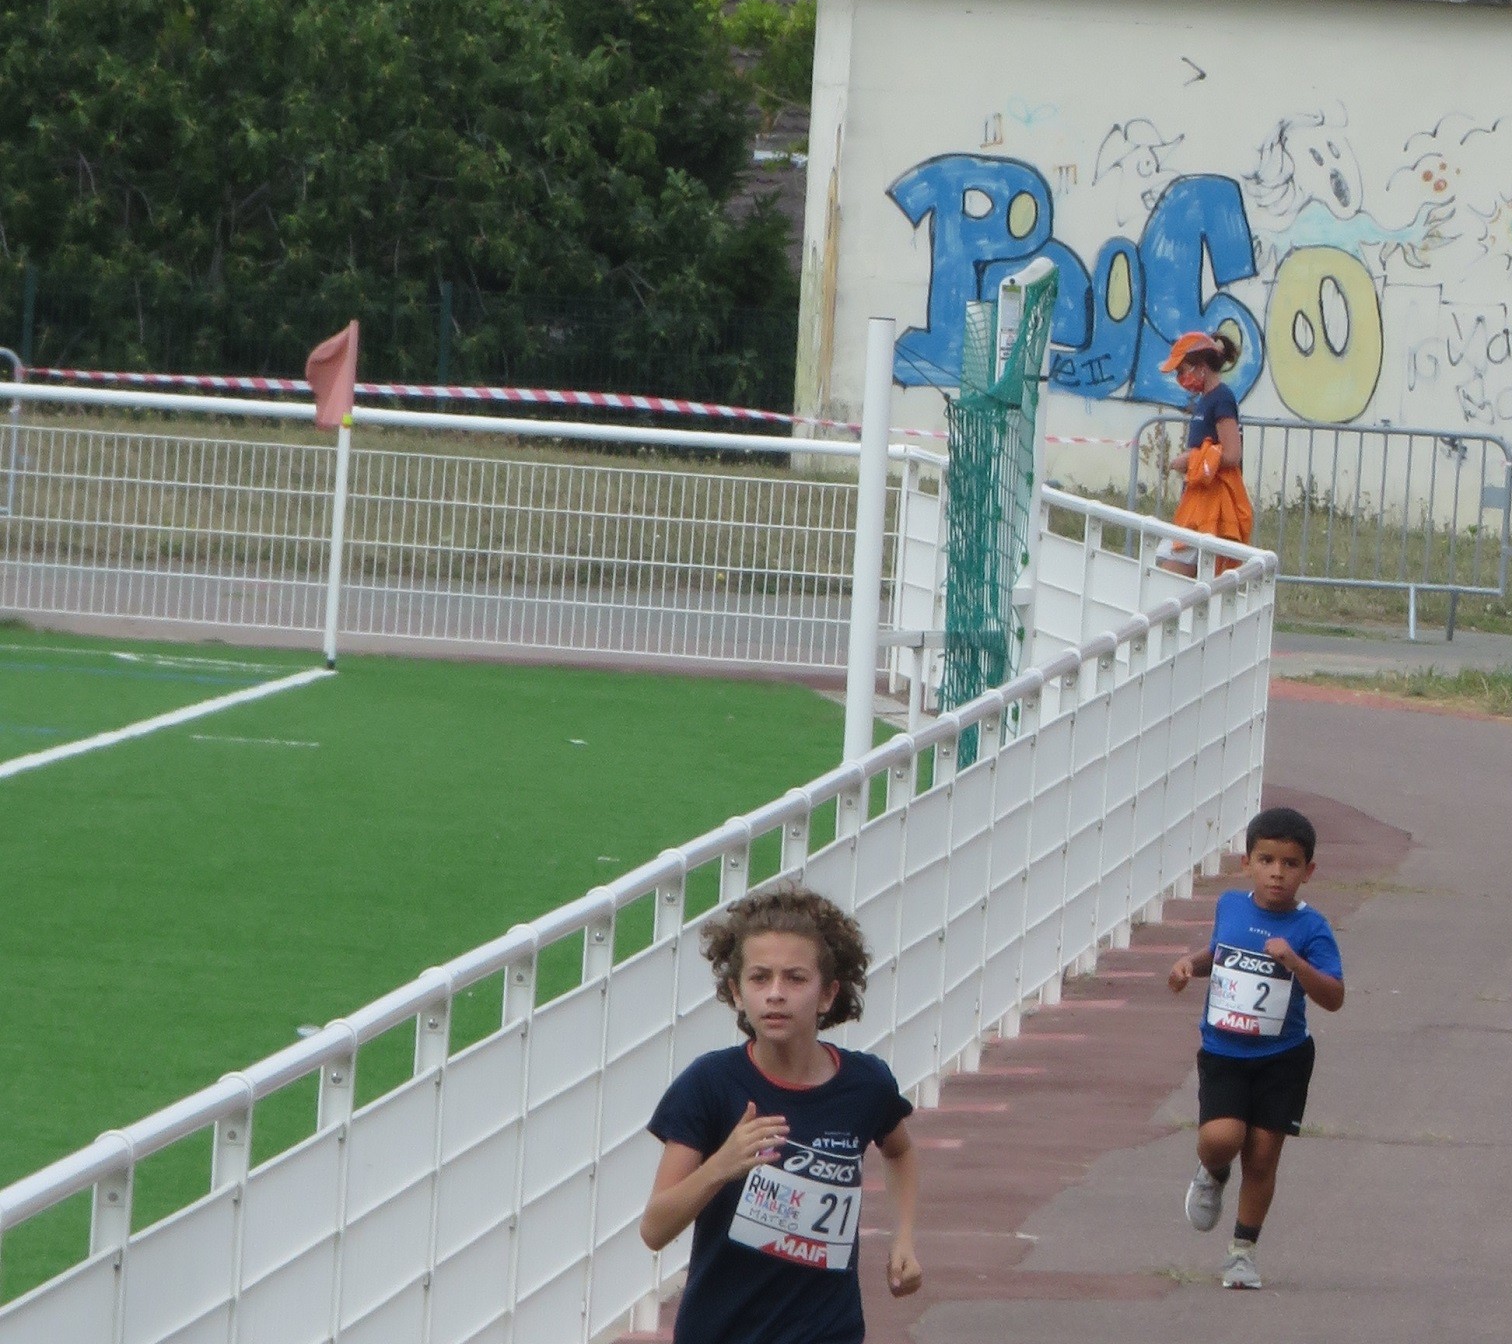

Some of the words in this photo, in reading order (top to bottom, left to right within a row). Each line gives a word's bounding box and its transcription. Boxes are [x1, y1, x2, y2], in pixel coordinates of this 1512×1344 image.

[1253, 982, 1271, 1012] 2
[1223, 1014, 1259, 1031] MAIF
[811, 1193, 853, 1236] 21
[775, 1238, 827, 1262] MAIF
